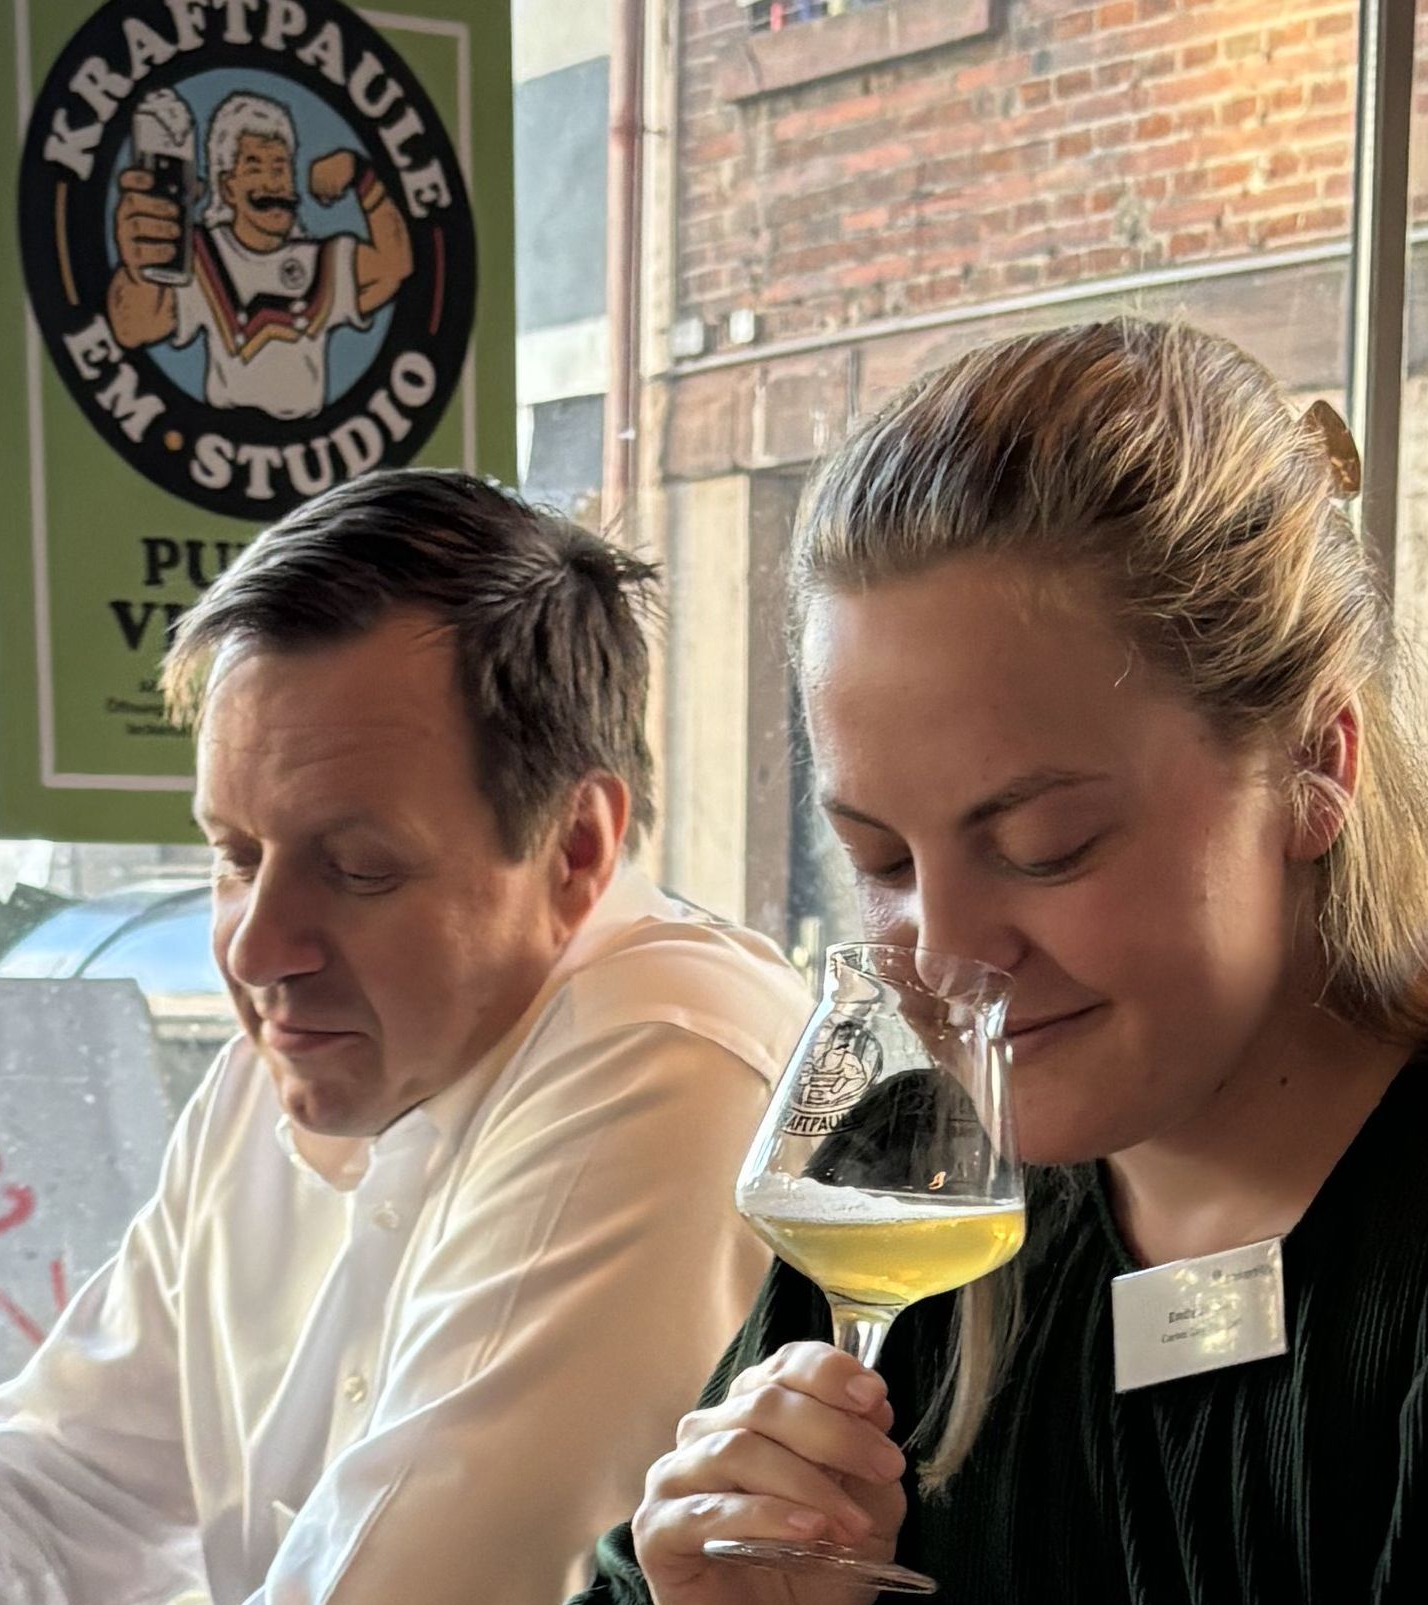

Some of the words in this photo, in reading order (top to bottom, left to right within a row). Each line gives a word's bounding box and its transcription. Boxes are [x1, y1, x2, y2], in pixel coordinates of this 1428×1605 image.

[43, 0, 453, 219] KRAFTPAULE
[62, 313, 167, 443] EM
[189, 351, 437, 500] STUDIO
[141, 537, 249, 590] PU
